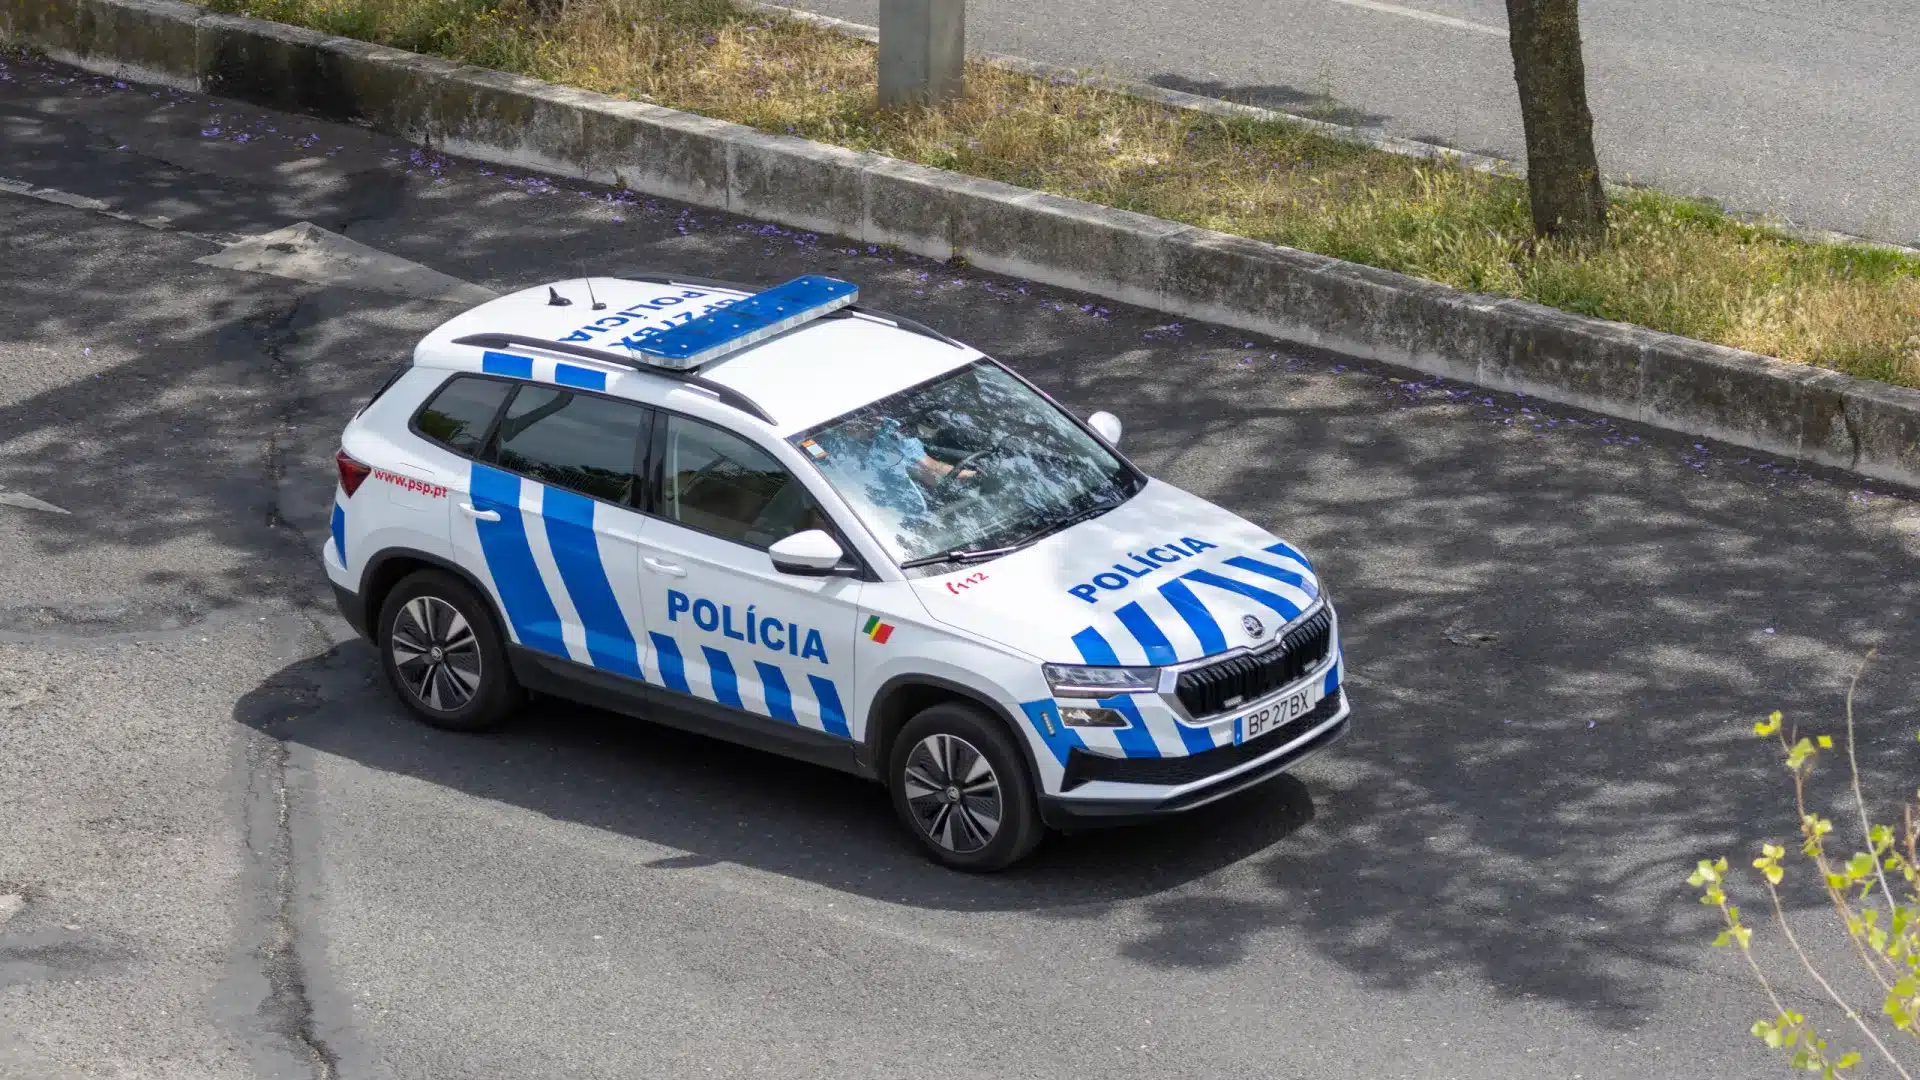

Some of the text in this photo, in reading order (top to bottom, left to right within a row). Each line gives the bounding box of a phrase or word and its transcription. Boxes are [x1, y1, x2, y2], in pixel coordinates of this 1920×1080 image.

[557, 290, 709, 342] POLÍCIA
[374, 469, 448, 499] www.psp.pt
[957, 572, 990, 589] 112
[1067, 536, 1218, 604] POLÍCIA
[667, 588, 829, 665] POLÍCIA
[1248, 689, 1309, 736] BP 27 BX
